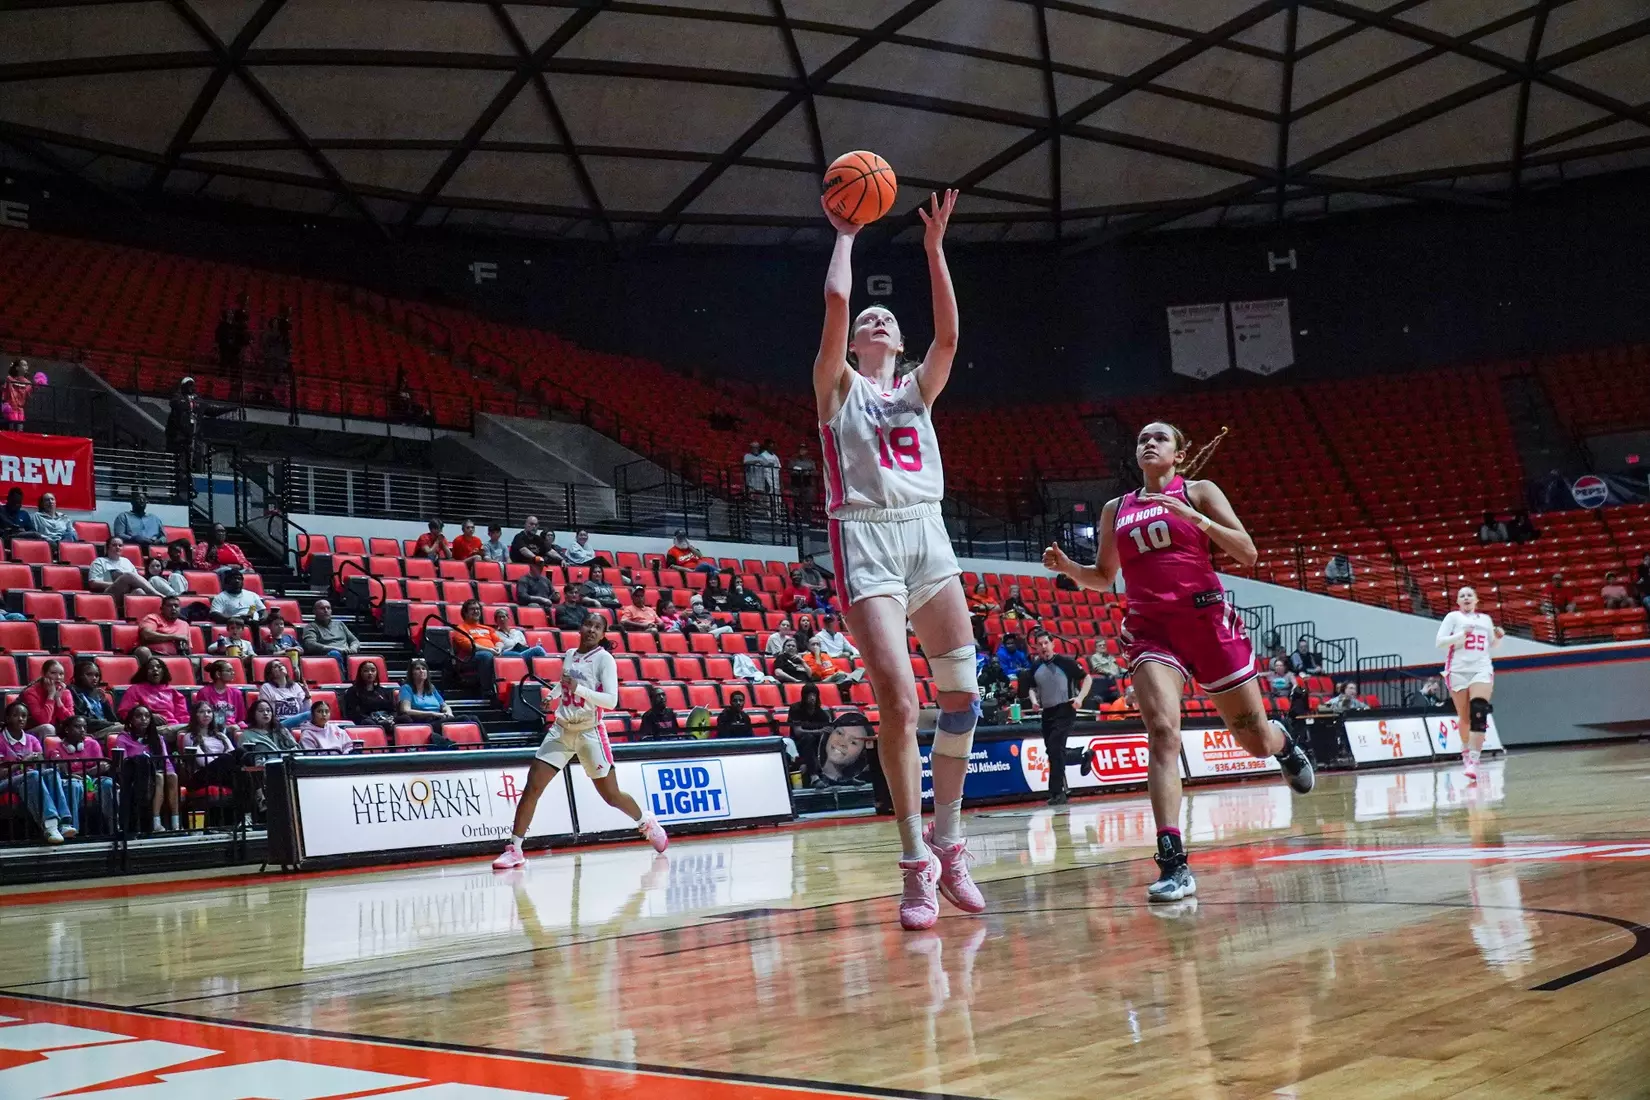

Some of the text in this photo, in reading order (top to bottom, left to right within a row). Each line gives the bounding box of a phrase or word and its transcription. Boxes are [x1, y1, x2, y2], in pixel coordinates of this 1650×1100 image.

[0, 200, 29, 229] E
[473, 261, 498, 285] F
[1267, 248, 1297, 273] H
[866, 274, 893, 296] G
[1135, 505, 1169, 522] HOUS
[1130, 520, 1172, 554] 10
[1464, 632, 1486, 651] 25
[1204, 730, 1241, 749] ART
[658, 766, 710, 791] BUD
[979, 760, 1011, 774] Athletics
[352, 777, 480, 806] MEMORIAL
[651, 789, 722, 816] LIGHT
[354, 796, 481, 825] HERMANN
